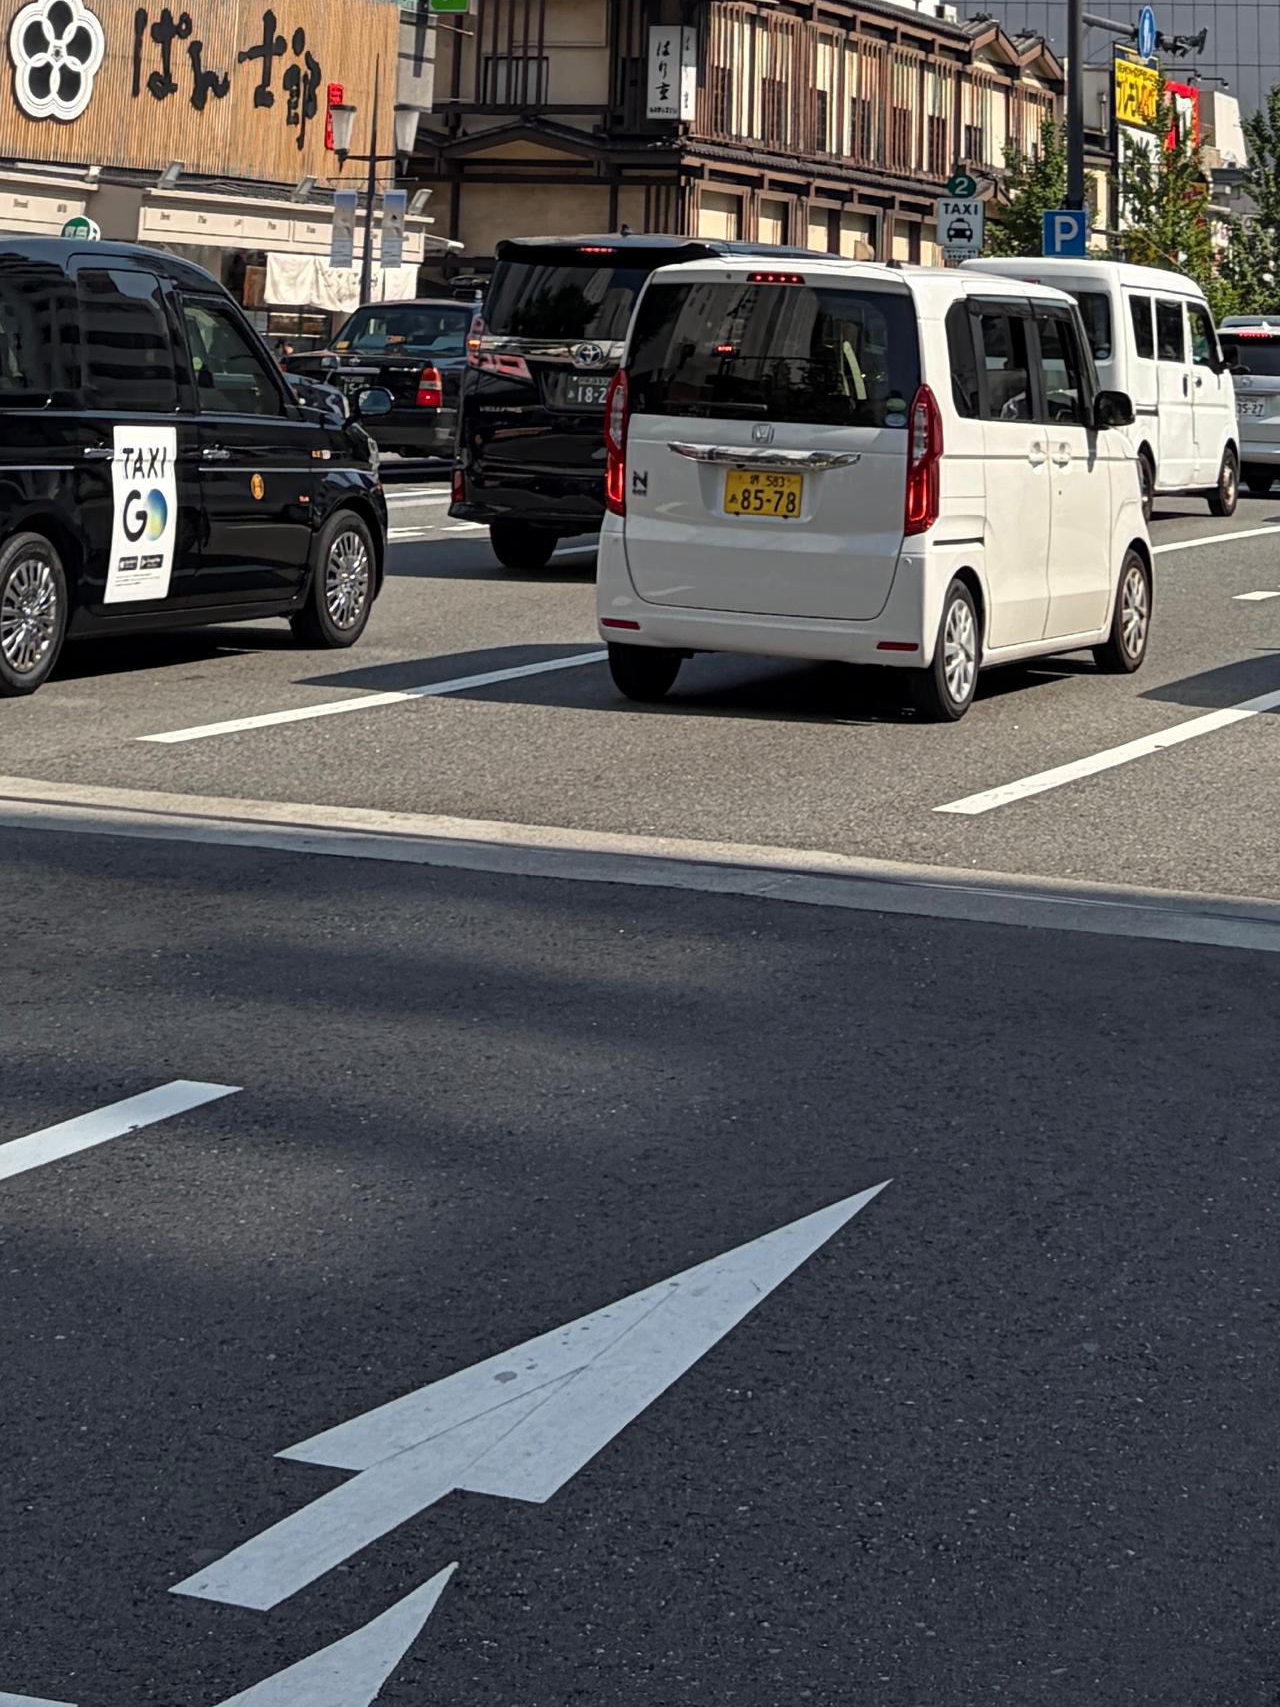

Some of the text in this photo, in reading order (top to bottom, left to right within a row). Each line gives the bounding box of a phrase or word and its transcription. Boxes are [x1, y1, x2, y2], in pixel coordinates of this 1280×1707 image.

[955, 178, 969, 195] 2
[943, 202, 979, 215] TAXI
[1054, 215, 1079, 253] P
[577, 385, 608, 403] 18-2
[122, 446, 167, 480] TAXI
[741, 488, 797, 514] 85-78
[123, 488, 168, 543] GO
